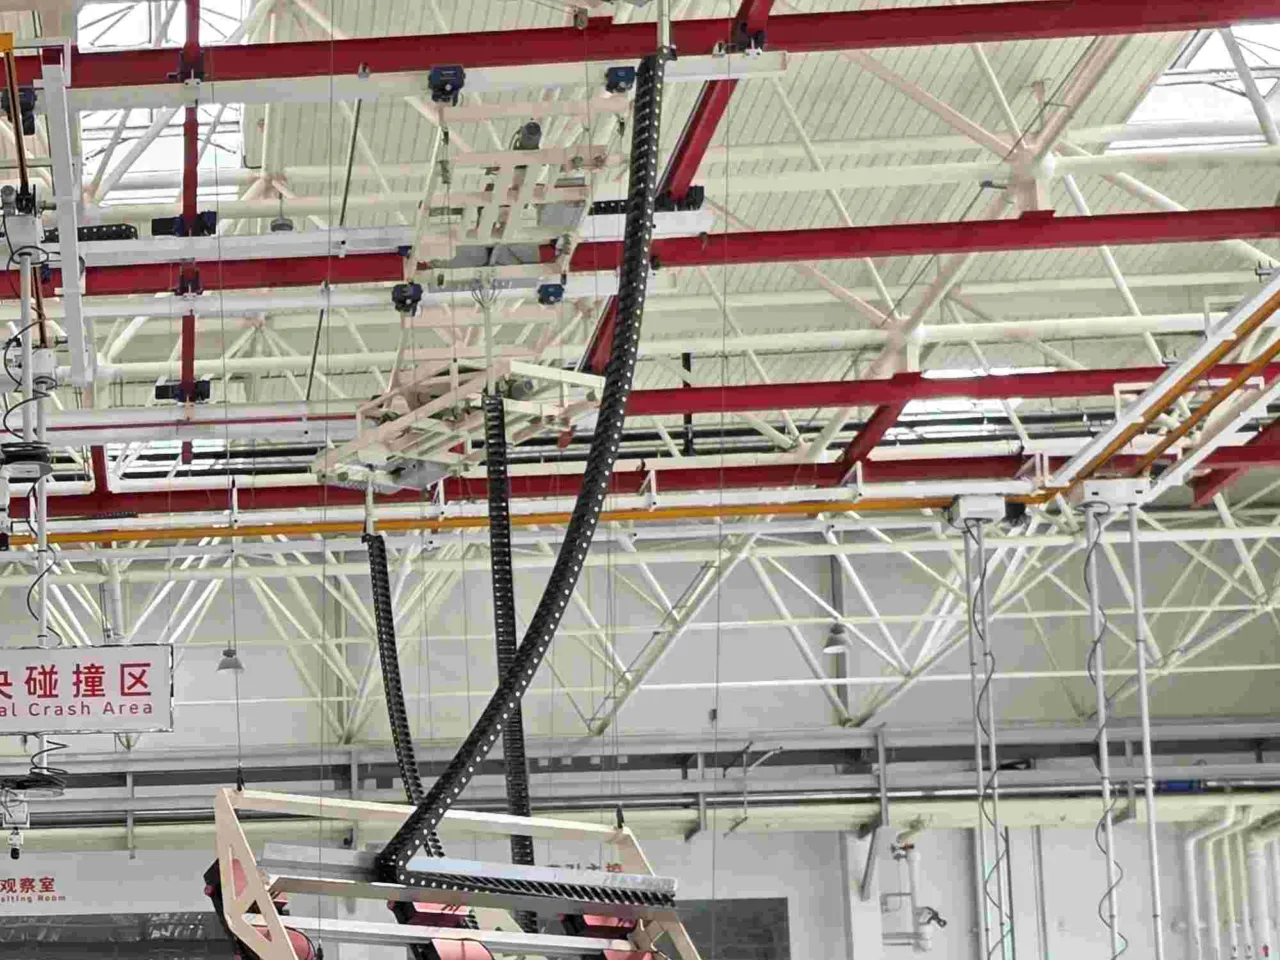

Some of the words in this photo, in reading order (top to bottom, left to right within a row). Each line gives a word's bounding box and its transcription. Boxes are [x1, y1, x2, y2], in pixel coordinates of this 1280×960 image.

[28, 701, 91, 717] Crash
[102, 700, 153, 716] Area
[0, 876, 56, 894] 观察室
